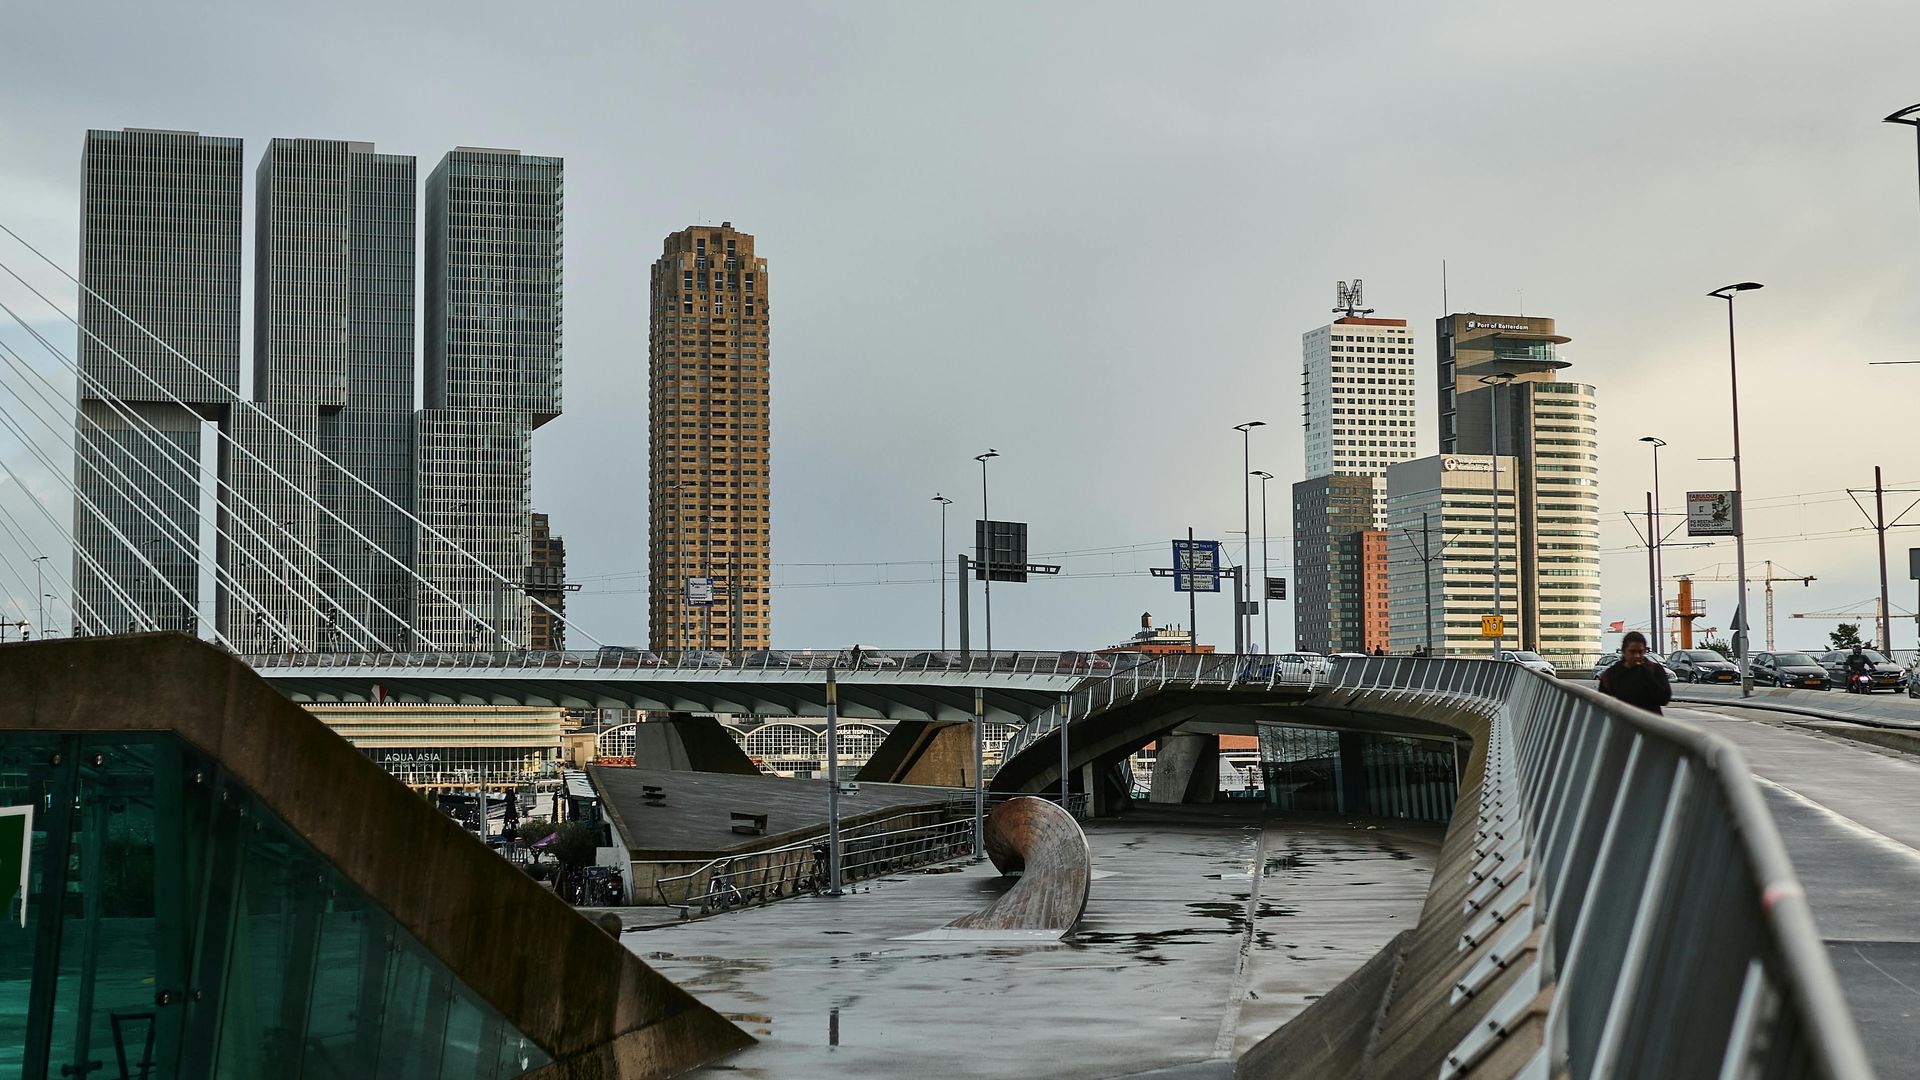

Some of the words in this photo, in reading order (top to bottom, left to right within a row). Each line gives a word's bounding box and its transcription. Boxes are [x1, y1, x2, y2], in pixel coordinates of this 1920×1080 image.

[1337, 279, 1362, 307] M
[1498, 323, 1529, 331] Rotterdam
[385, 753, 414, 762] AQUA
[417, 753, 440, 761] ASIA
